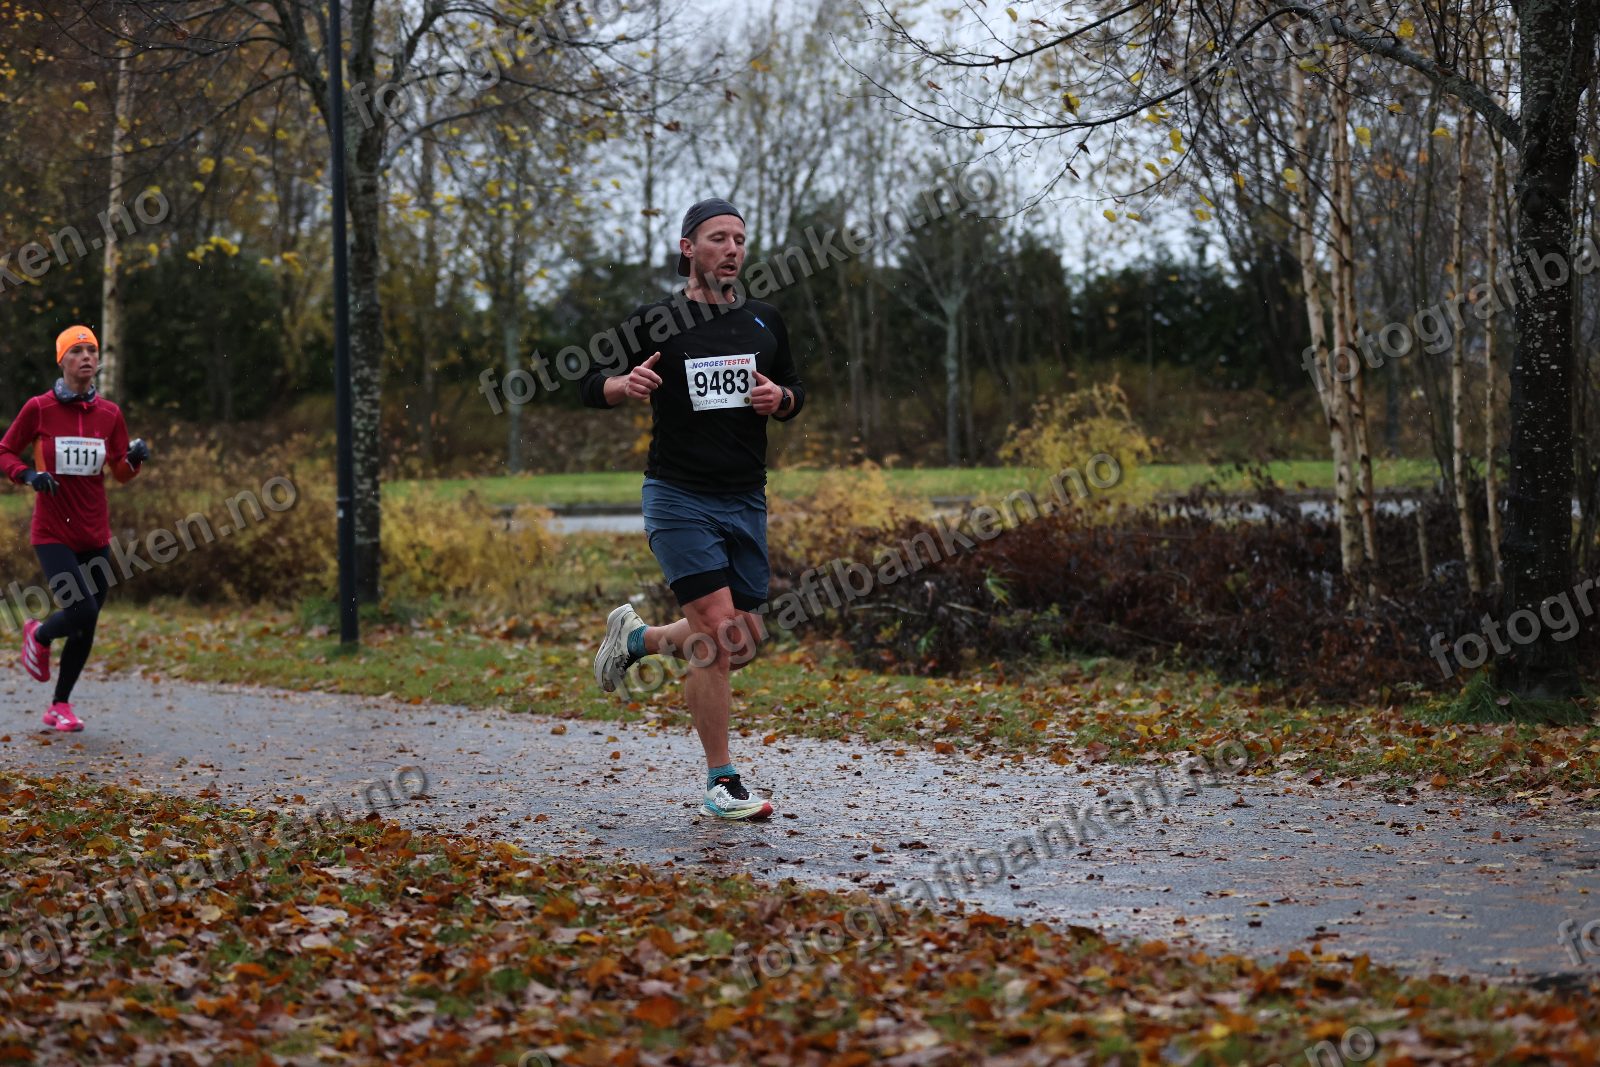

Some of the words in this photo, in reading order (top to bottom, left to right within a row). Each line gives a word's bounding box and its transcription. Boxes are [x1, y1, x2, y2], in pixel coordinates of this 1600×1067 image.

[691, 358, 751, 369] NORGESTESTEN
[694, 369, 749, 397] 9483
[64, 447, 97, 467] 1111
